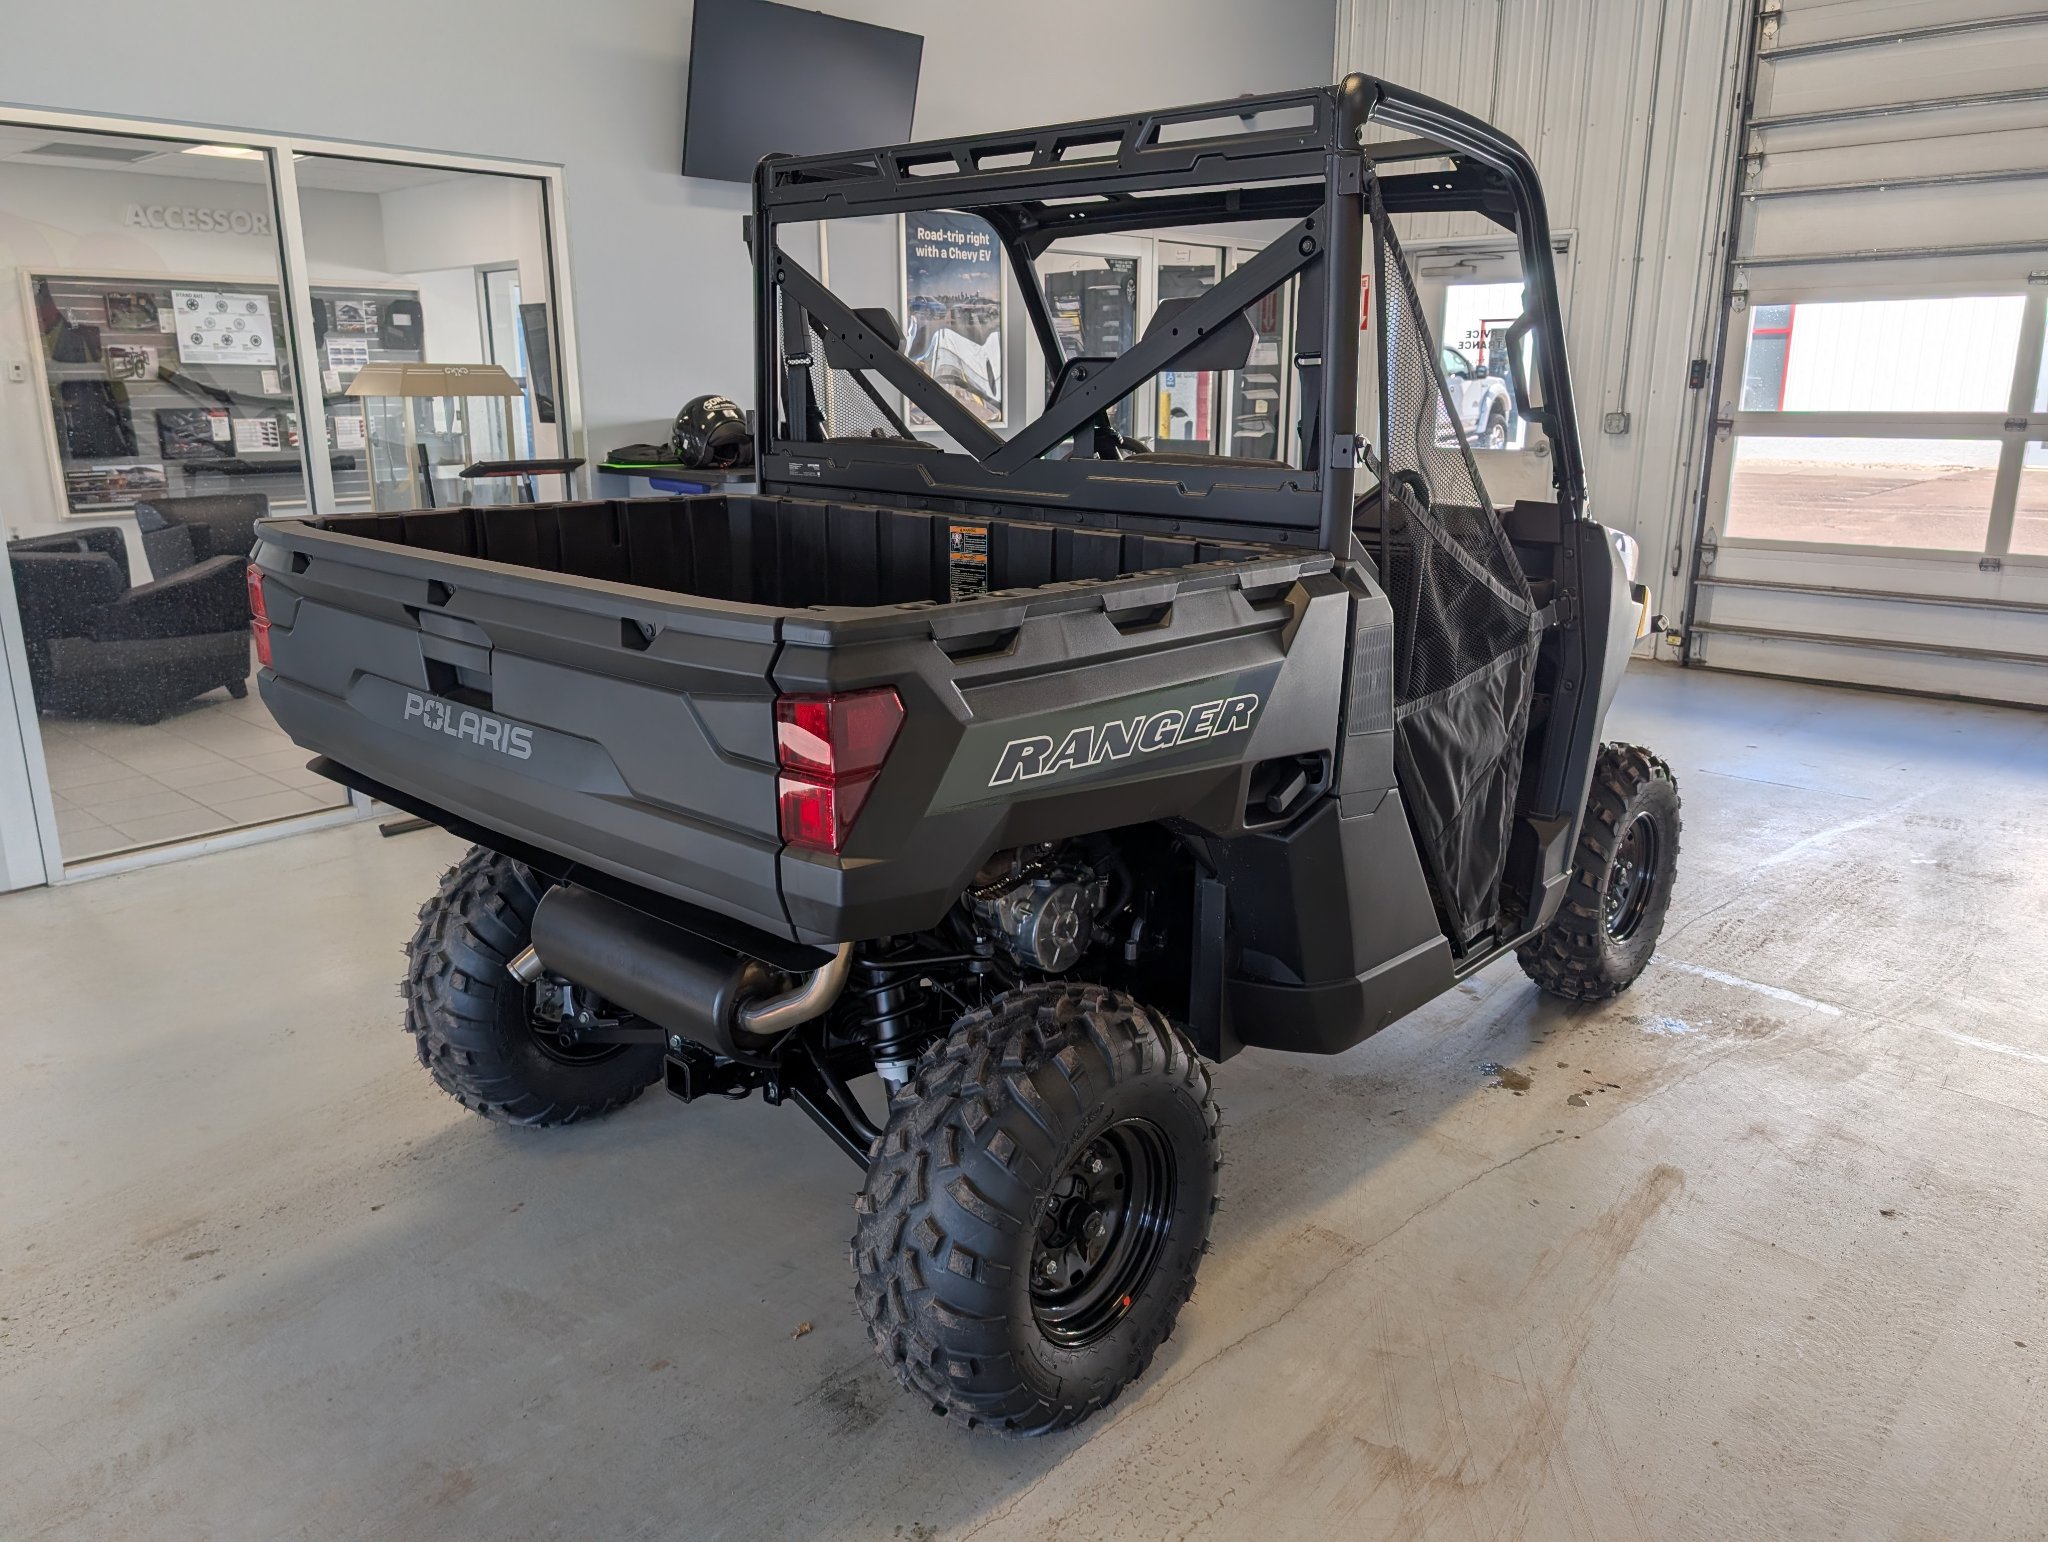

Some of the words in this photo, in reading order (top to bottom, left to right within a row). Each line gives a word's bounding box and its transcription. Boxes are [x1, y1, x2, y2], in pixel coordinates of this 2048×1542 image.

[124, 203, 271, 236] ACCESSOR
[917, 227, 965, 245] Road-trip
[966, 231, 990, 246] right
[915, 244, 939, 258] with
[940, 249, 948, 259] a
[949, 246, 978, 263] Chevy
[979, 249, 992, 262] EV
[403, 692, 533, 760] POLARIS
[988, 693, 1259, 787] RANGER
